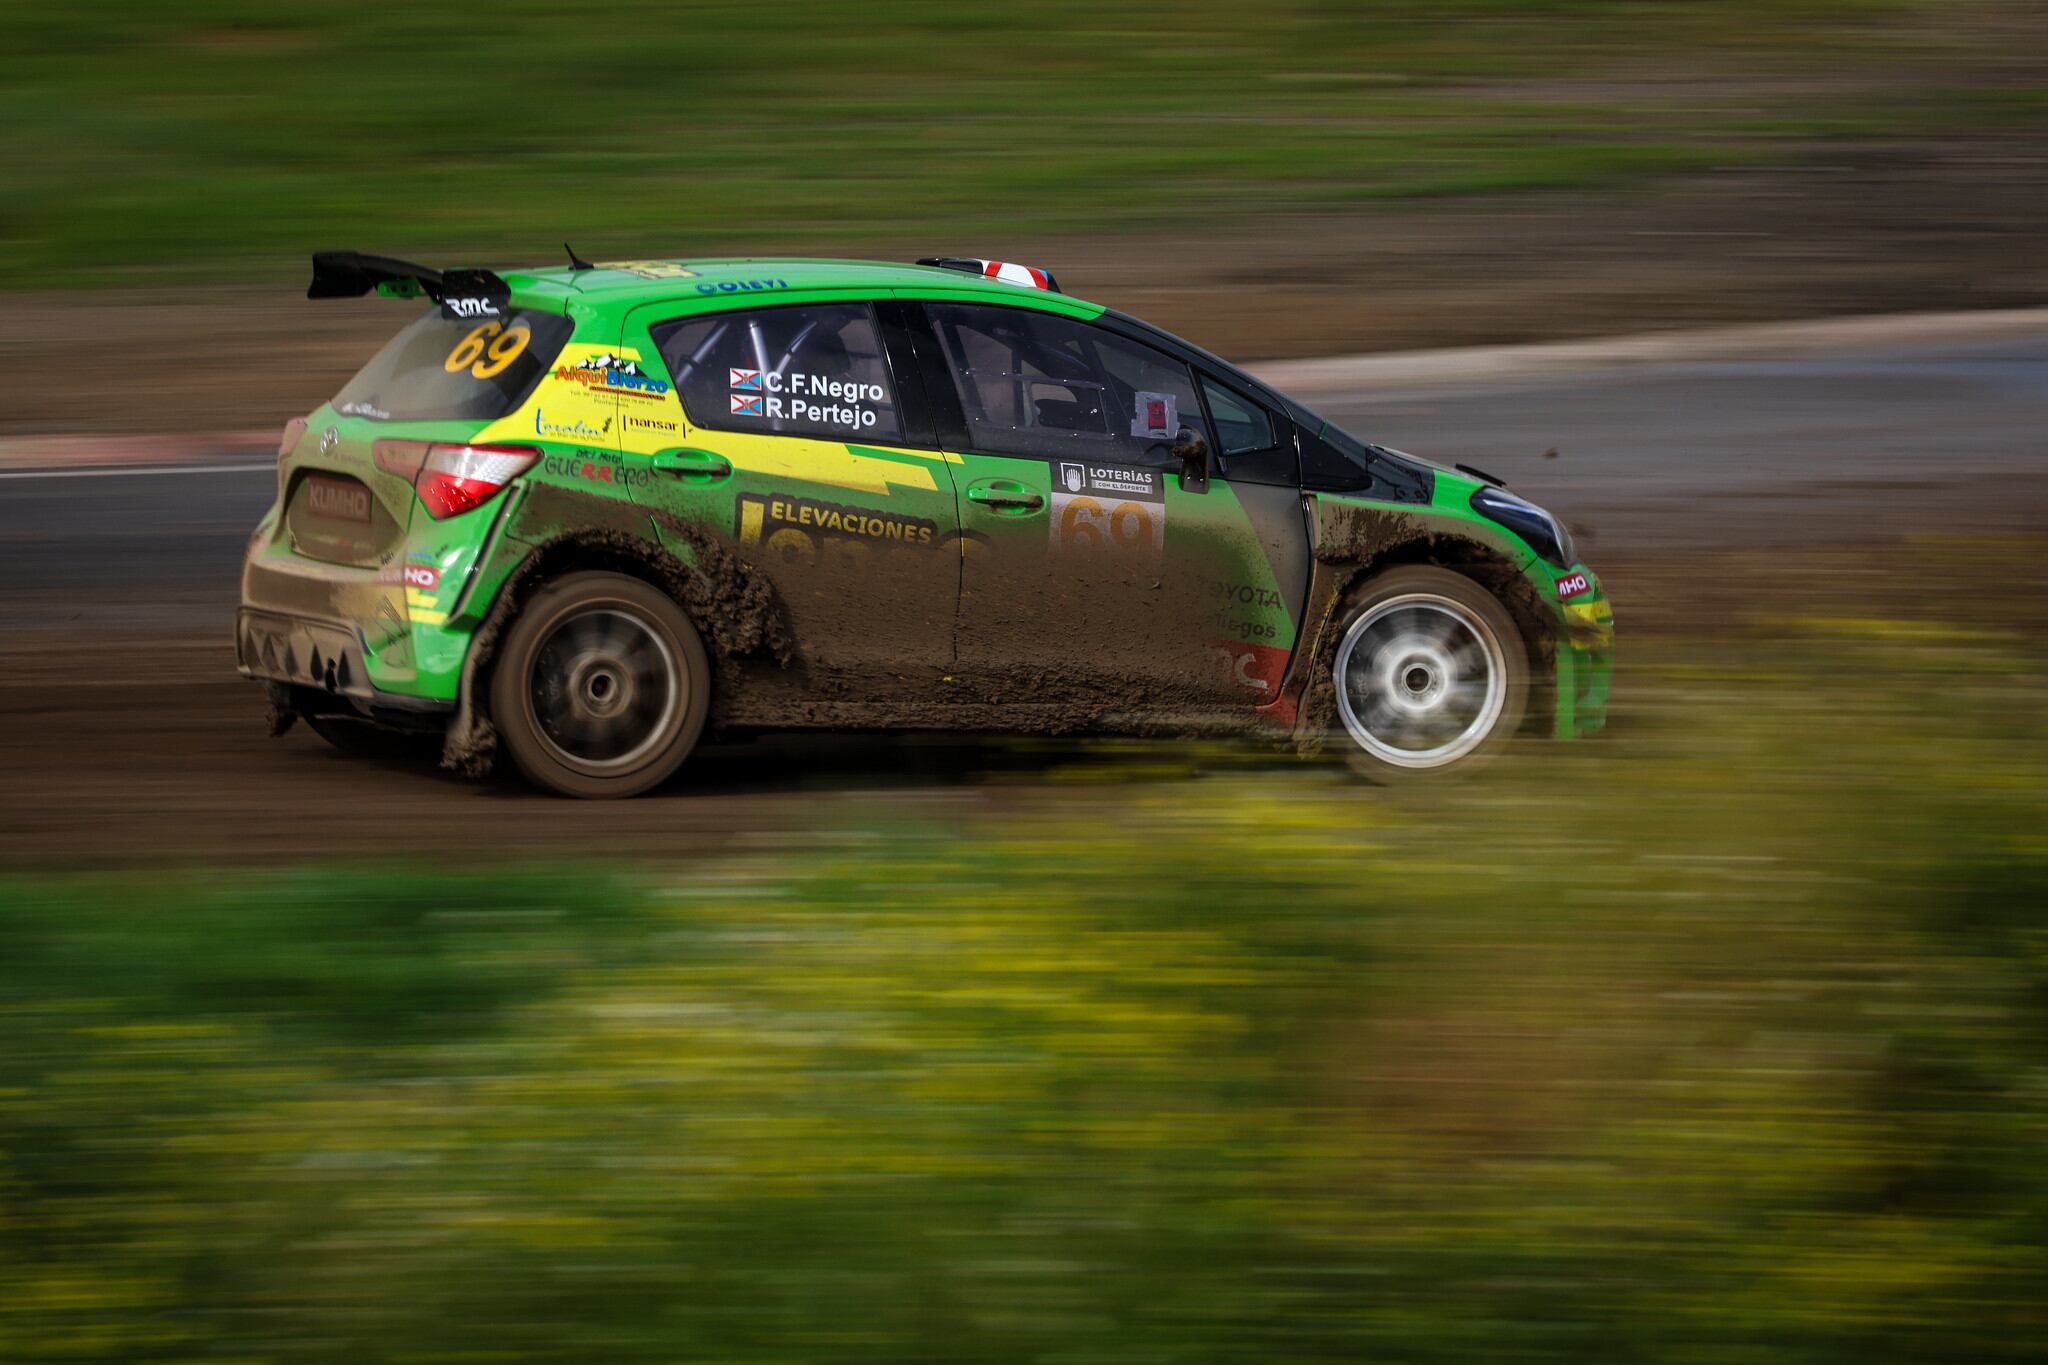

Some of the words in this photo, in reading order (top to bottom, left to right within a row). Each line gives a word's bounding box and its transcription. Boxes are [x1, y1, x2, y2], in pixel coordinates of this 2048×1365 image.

[445, 320, 531, 379] 69
[555, 366, 668, 393] AlquiBierzo
[766, 372, 884, 403] C.F.Negro
[630, 417, 678, 431] nansar
[766, 397, 877, 430] R.Pertejo
[310, 484, 367, 517] KUMHO
[771, 501, 932, 545] ELEVACIONES
[1061, 497, 1153, 547] 69
